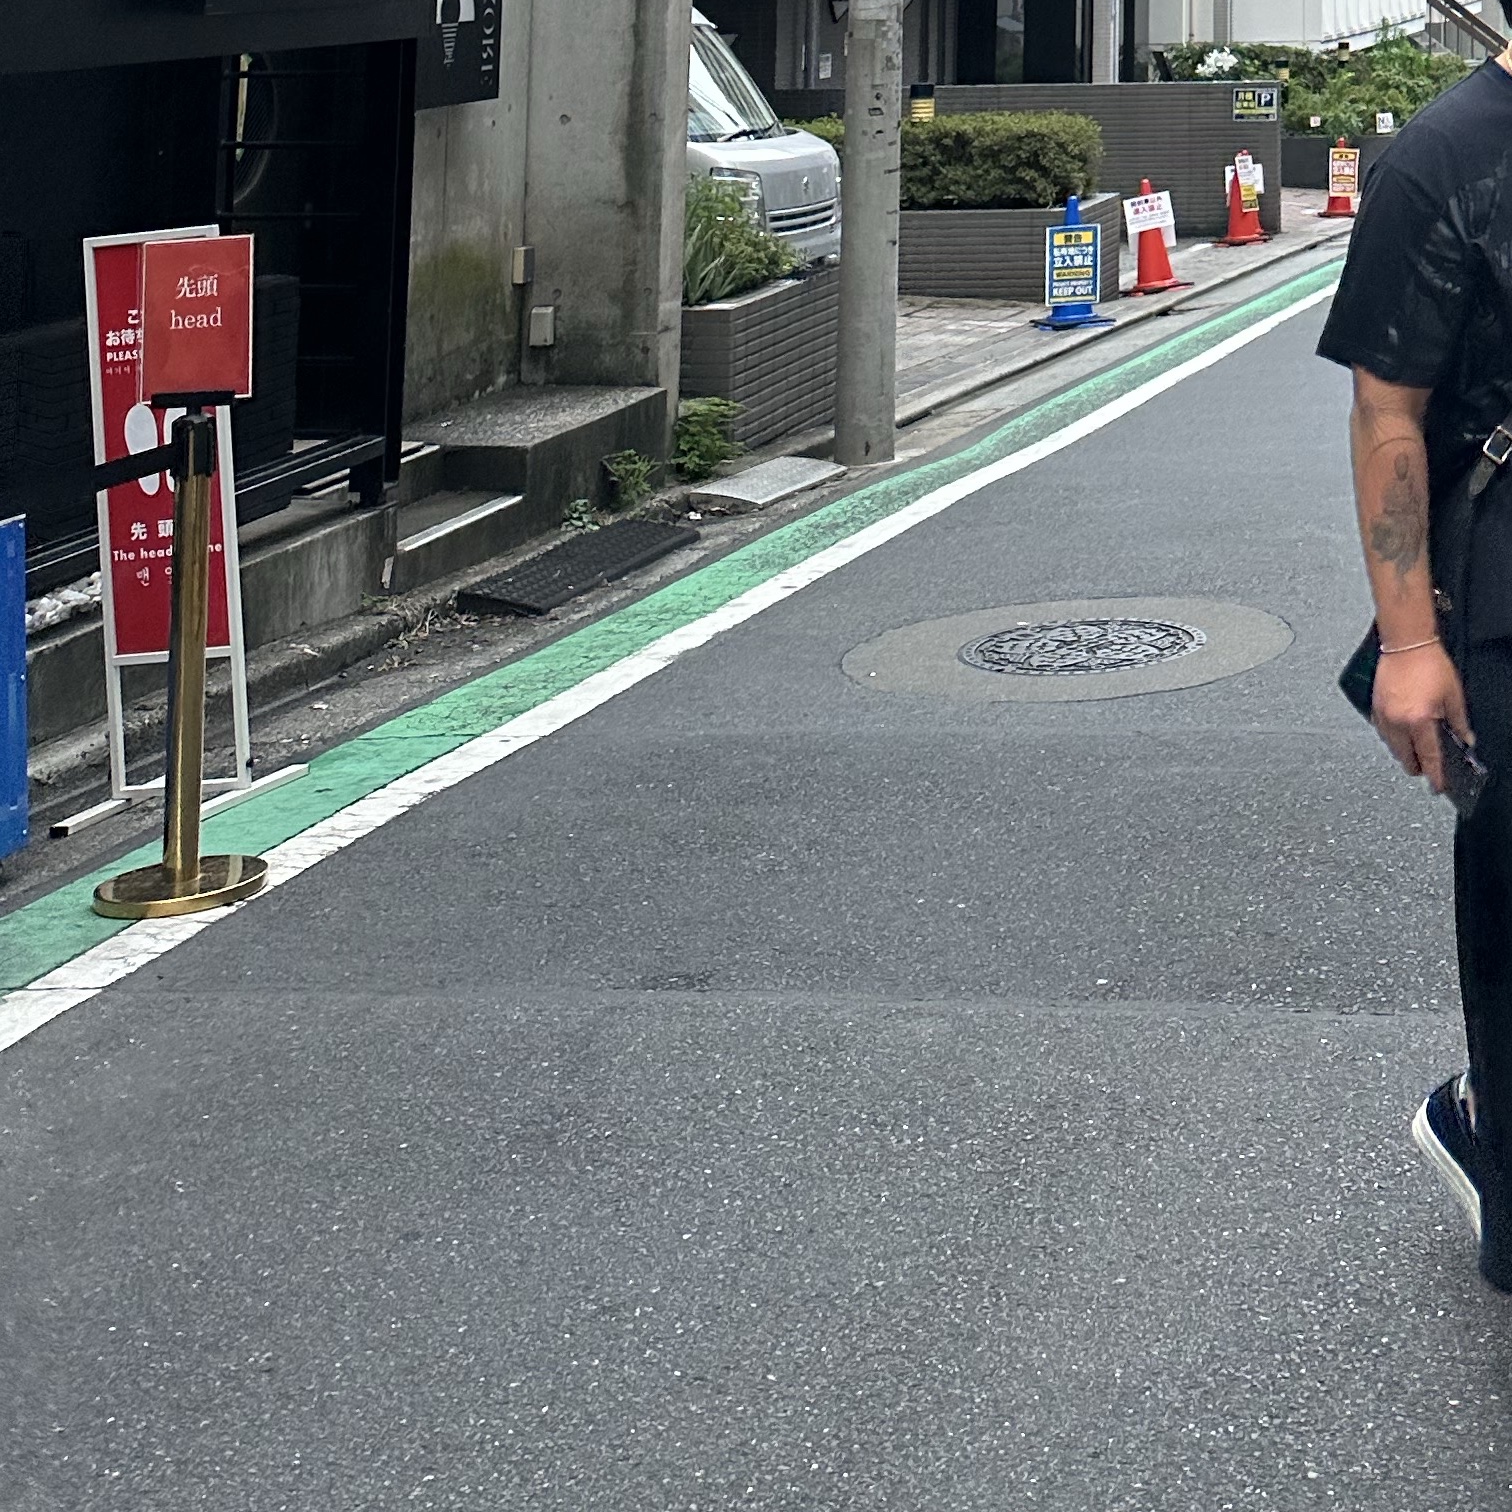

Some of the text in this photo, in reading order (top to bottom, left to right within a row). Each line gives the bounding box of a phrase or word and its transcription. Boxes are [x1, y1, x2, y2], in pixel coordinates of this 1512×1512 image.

[1053, 254, 1094, 268] 立入禁止
[175, 274, 218, 299] 先頭
[1075, 285, 1093, 295] OUT
[169, 307, 222, 330] head
[113, 550, 135, 561] The
[140, 545, 173, 558] head
